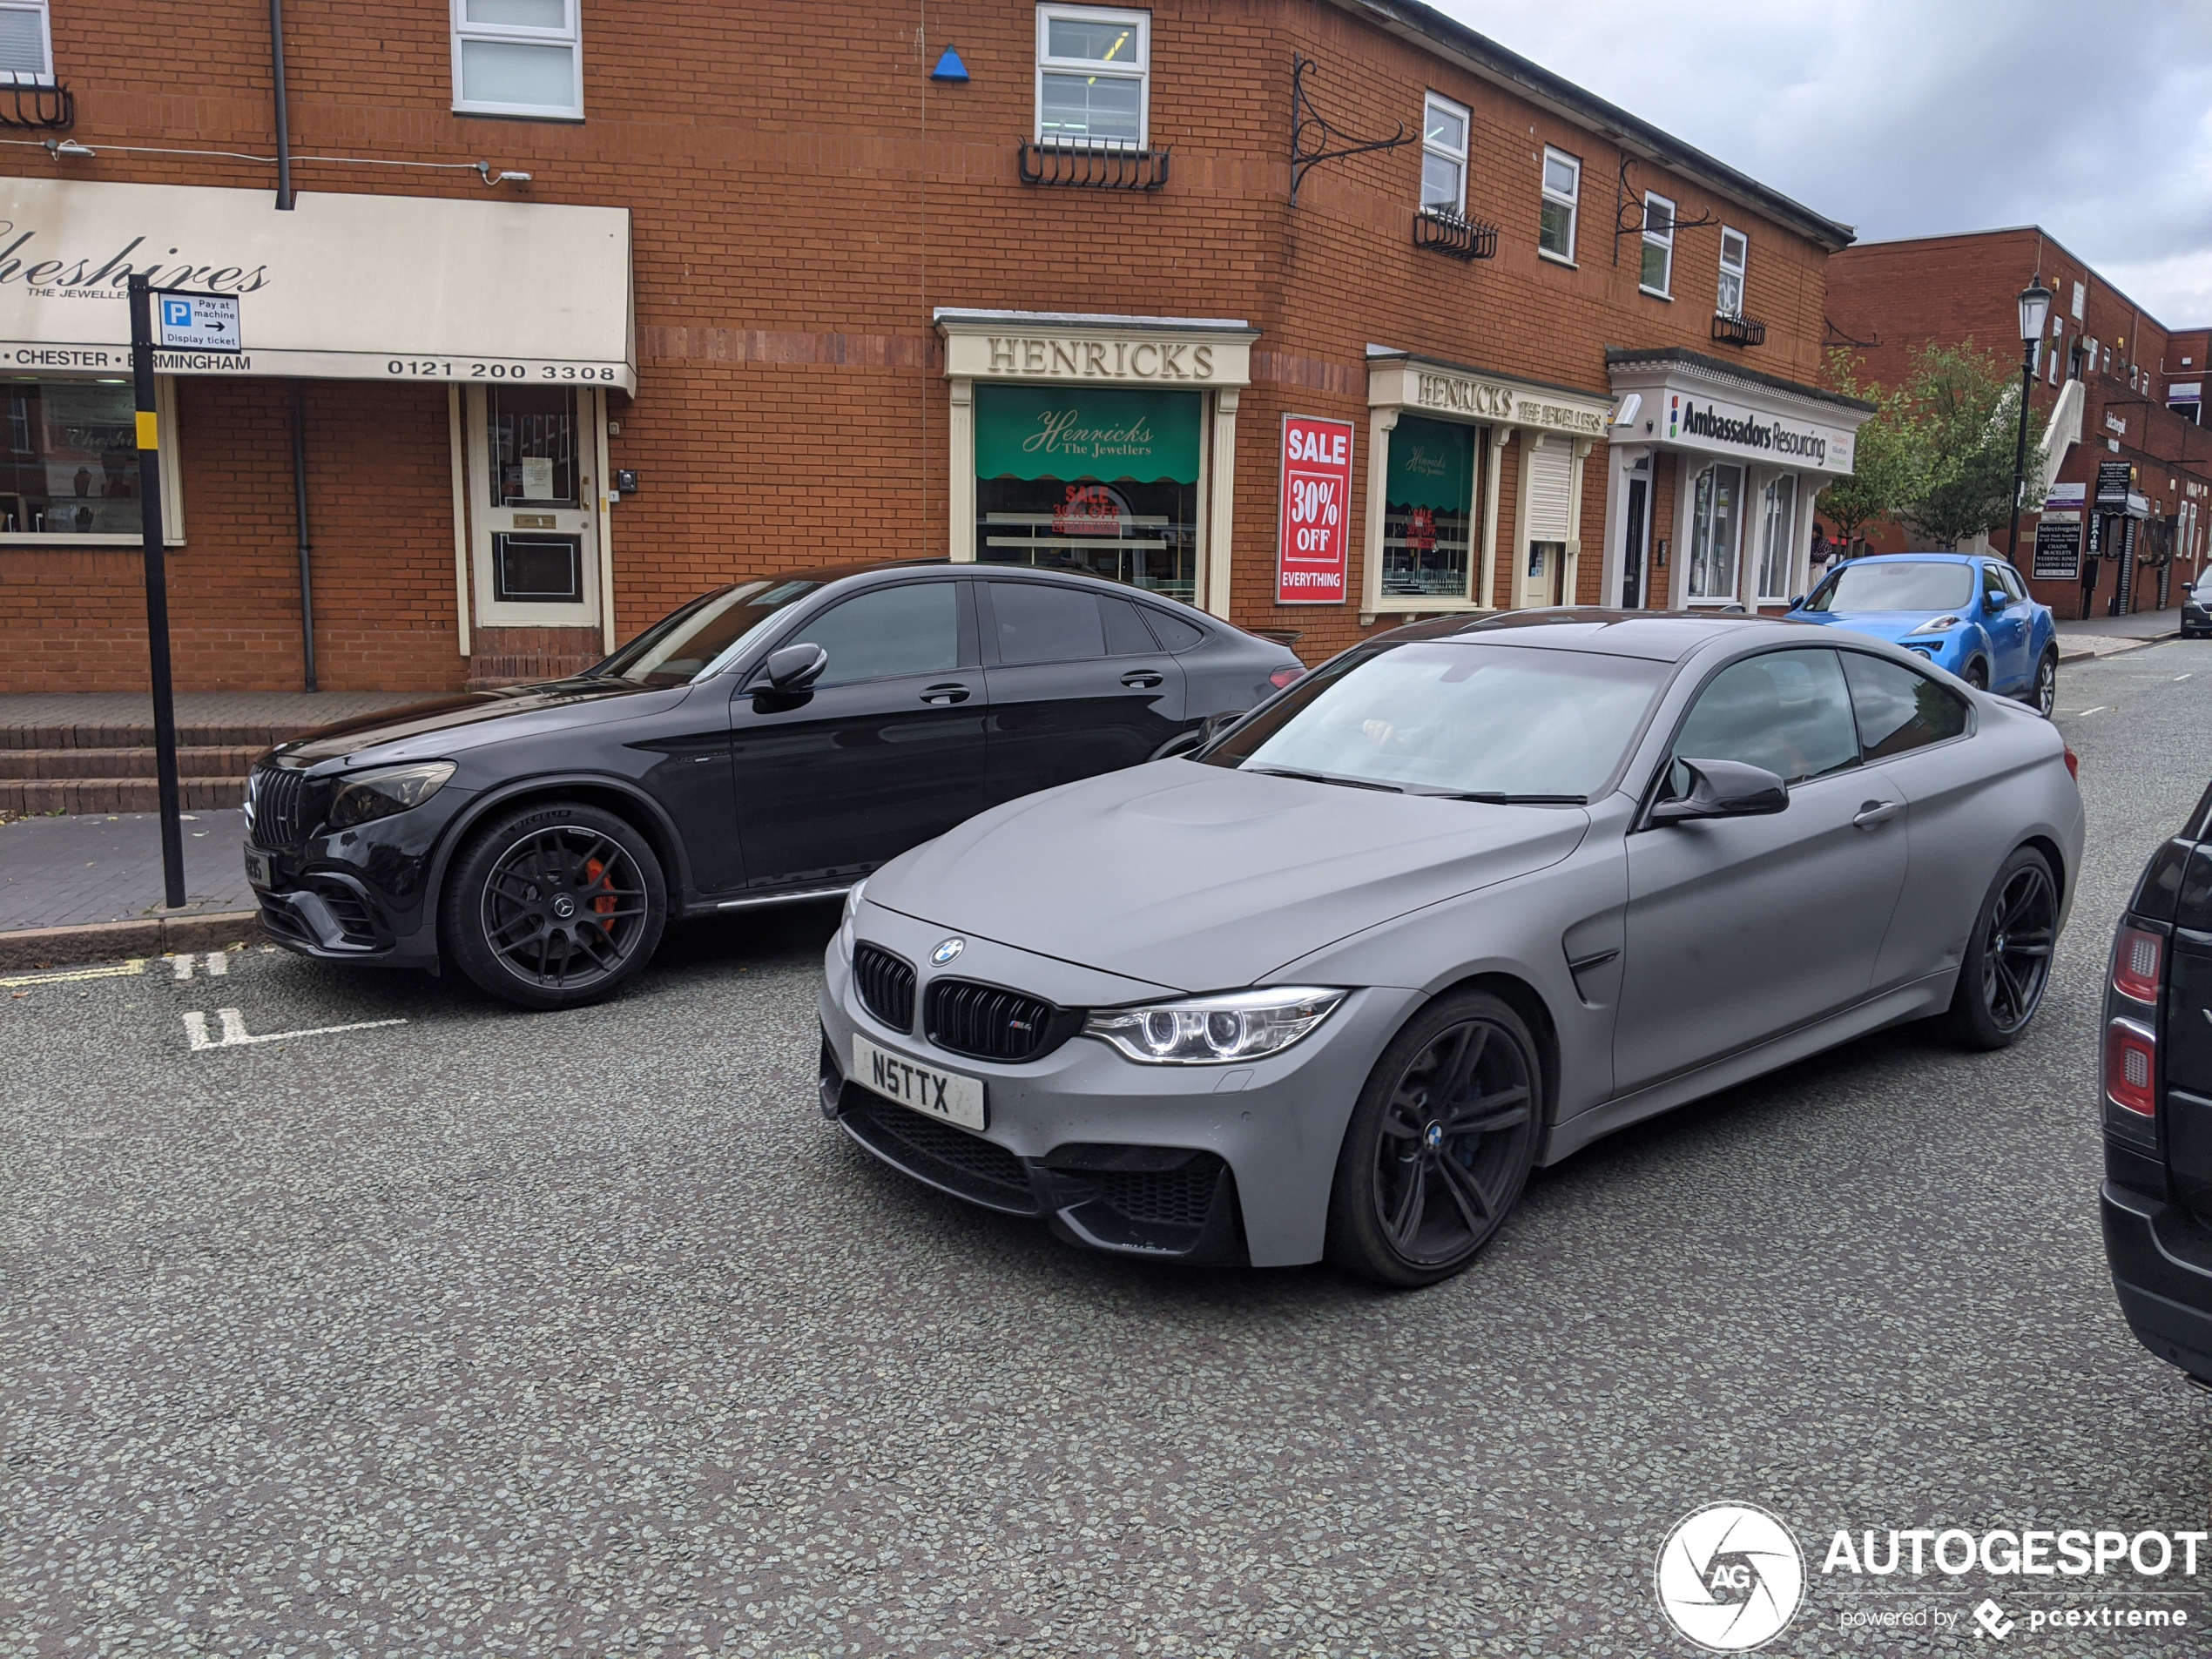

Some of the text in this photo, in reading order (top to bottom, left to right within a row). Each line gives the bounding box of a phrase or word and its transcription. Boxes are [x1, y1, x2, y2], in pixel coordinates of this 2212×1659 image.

[0, 220, 271, 293] heshires
[26, 287, 130, 300] THE JEWELLE
[170, 303, 187, 324] P
[194, 310, 235, 320] machine
[199, 300, 216, 309] Pay
[167, 334, 236, 345] Display ticket
[16, 349, 251, 370] CHESTER BRMINGHAM
[988, 337, 1214, 378] HENRICKS
[388, 360, 615, 381] 0121 200 3308
[1418, 374, 1513, 416] HENRICKS
[1517, 401, 1541, 420] THE
[1022, 409, 1154, 453] Henricks
[1683, 401, 1827, 466] Ambassadors Resourcing
[1062, 442, 1151, 458] The Jewellers
[1288, 428, 1346, 465] SALE
[1406, 446, 1446, 471] Henricks
[1065, 485, 1109, 503] SALE
[1291, 480, 1338, 526] 30%
[1053, 504, 1122, 519] 30% OFF
[1297, 528, 1331, 551] OFF
[2090, 514, 2100, 550] REPAIRS
[1282, 571, 1340, 587] EVERYTHING
[512, 809, 571, 830] MICHELIN
